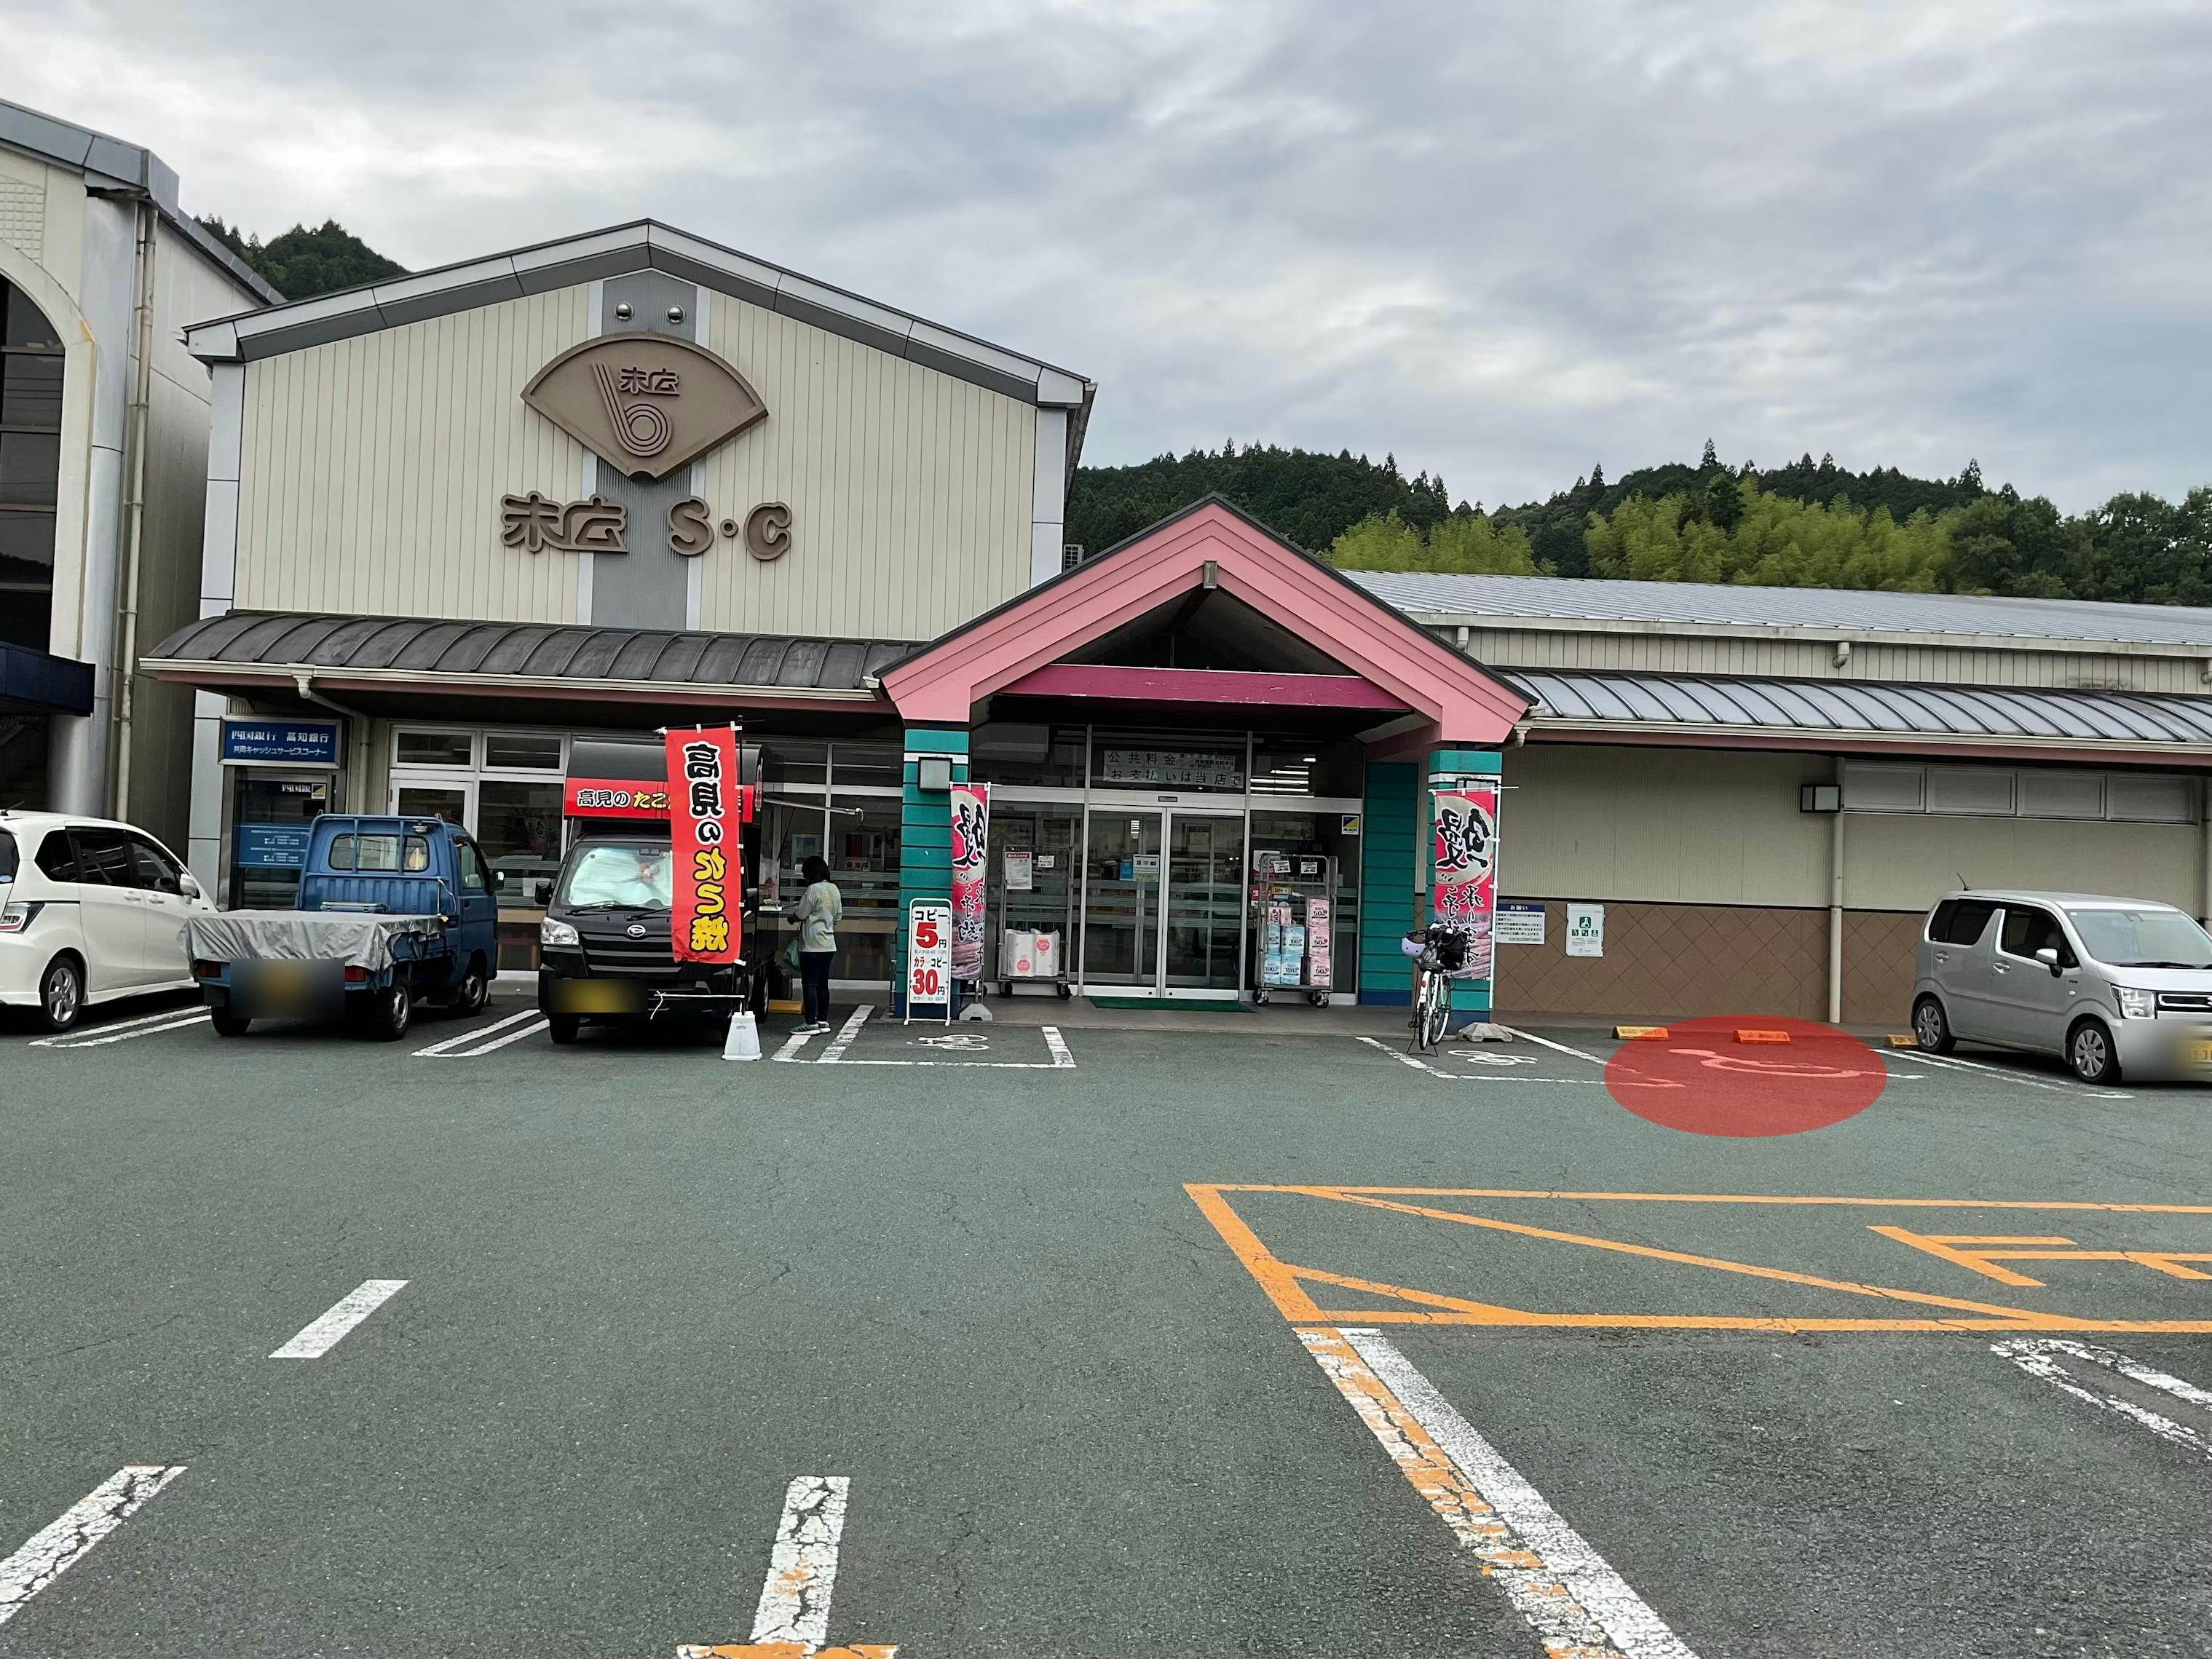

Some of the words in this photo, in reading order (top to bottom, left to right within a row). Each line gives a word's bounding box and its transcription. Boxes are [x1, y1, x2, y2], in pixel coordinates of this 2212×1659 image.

[619, 366, 679, 396] 末広
[500, 490, 628, 554] 末広
[232, 730, 277, 742] 四国銀行
[286, 732, 329, 743] 高知銀行
[1108, 752, 1177, 766] 公共料金
[1111, 769, 1241, 785] お支払いは当店で
[282, 784, 312, 793] 四国銀
[577, 789, 670, 809] 高見のたこ
[915, 909, 948, 922] コピー
